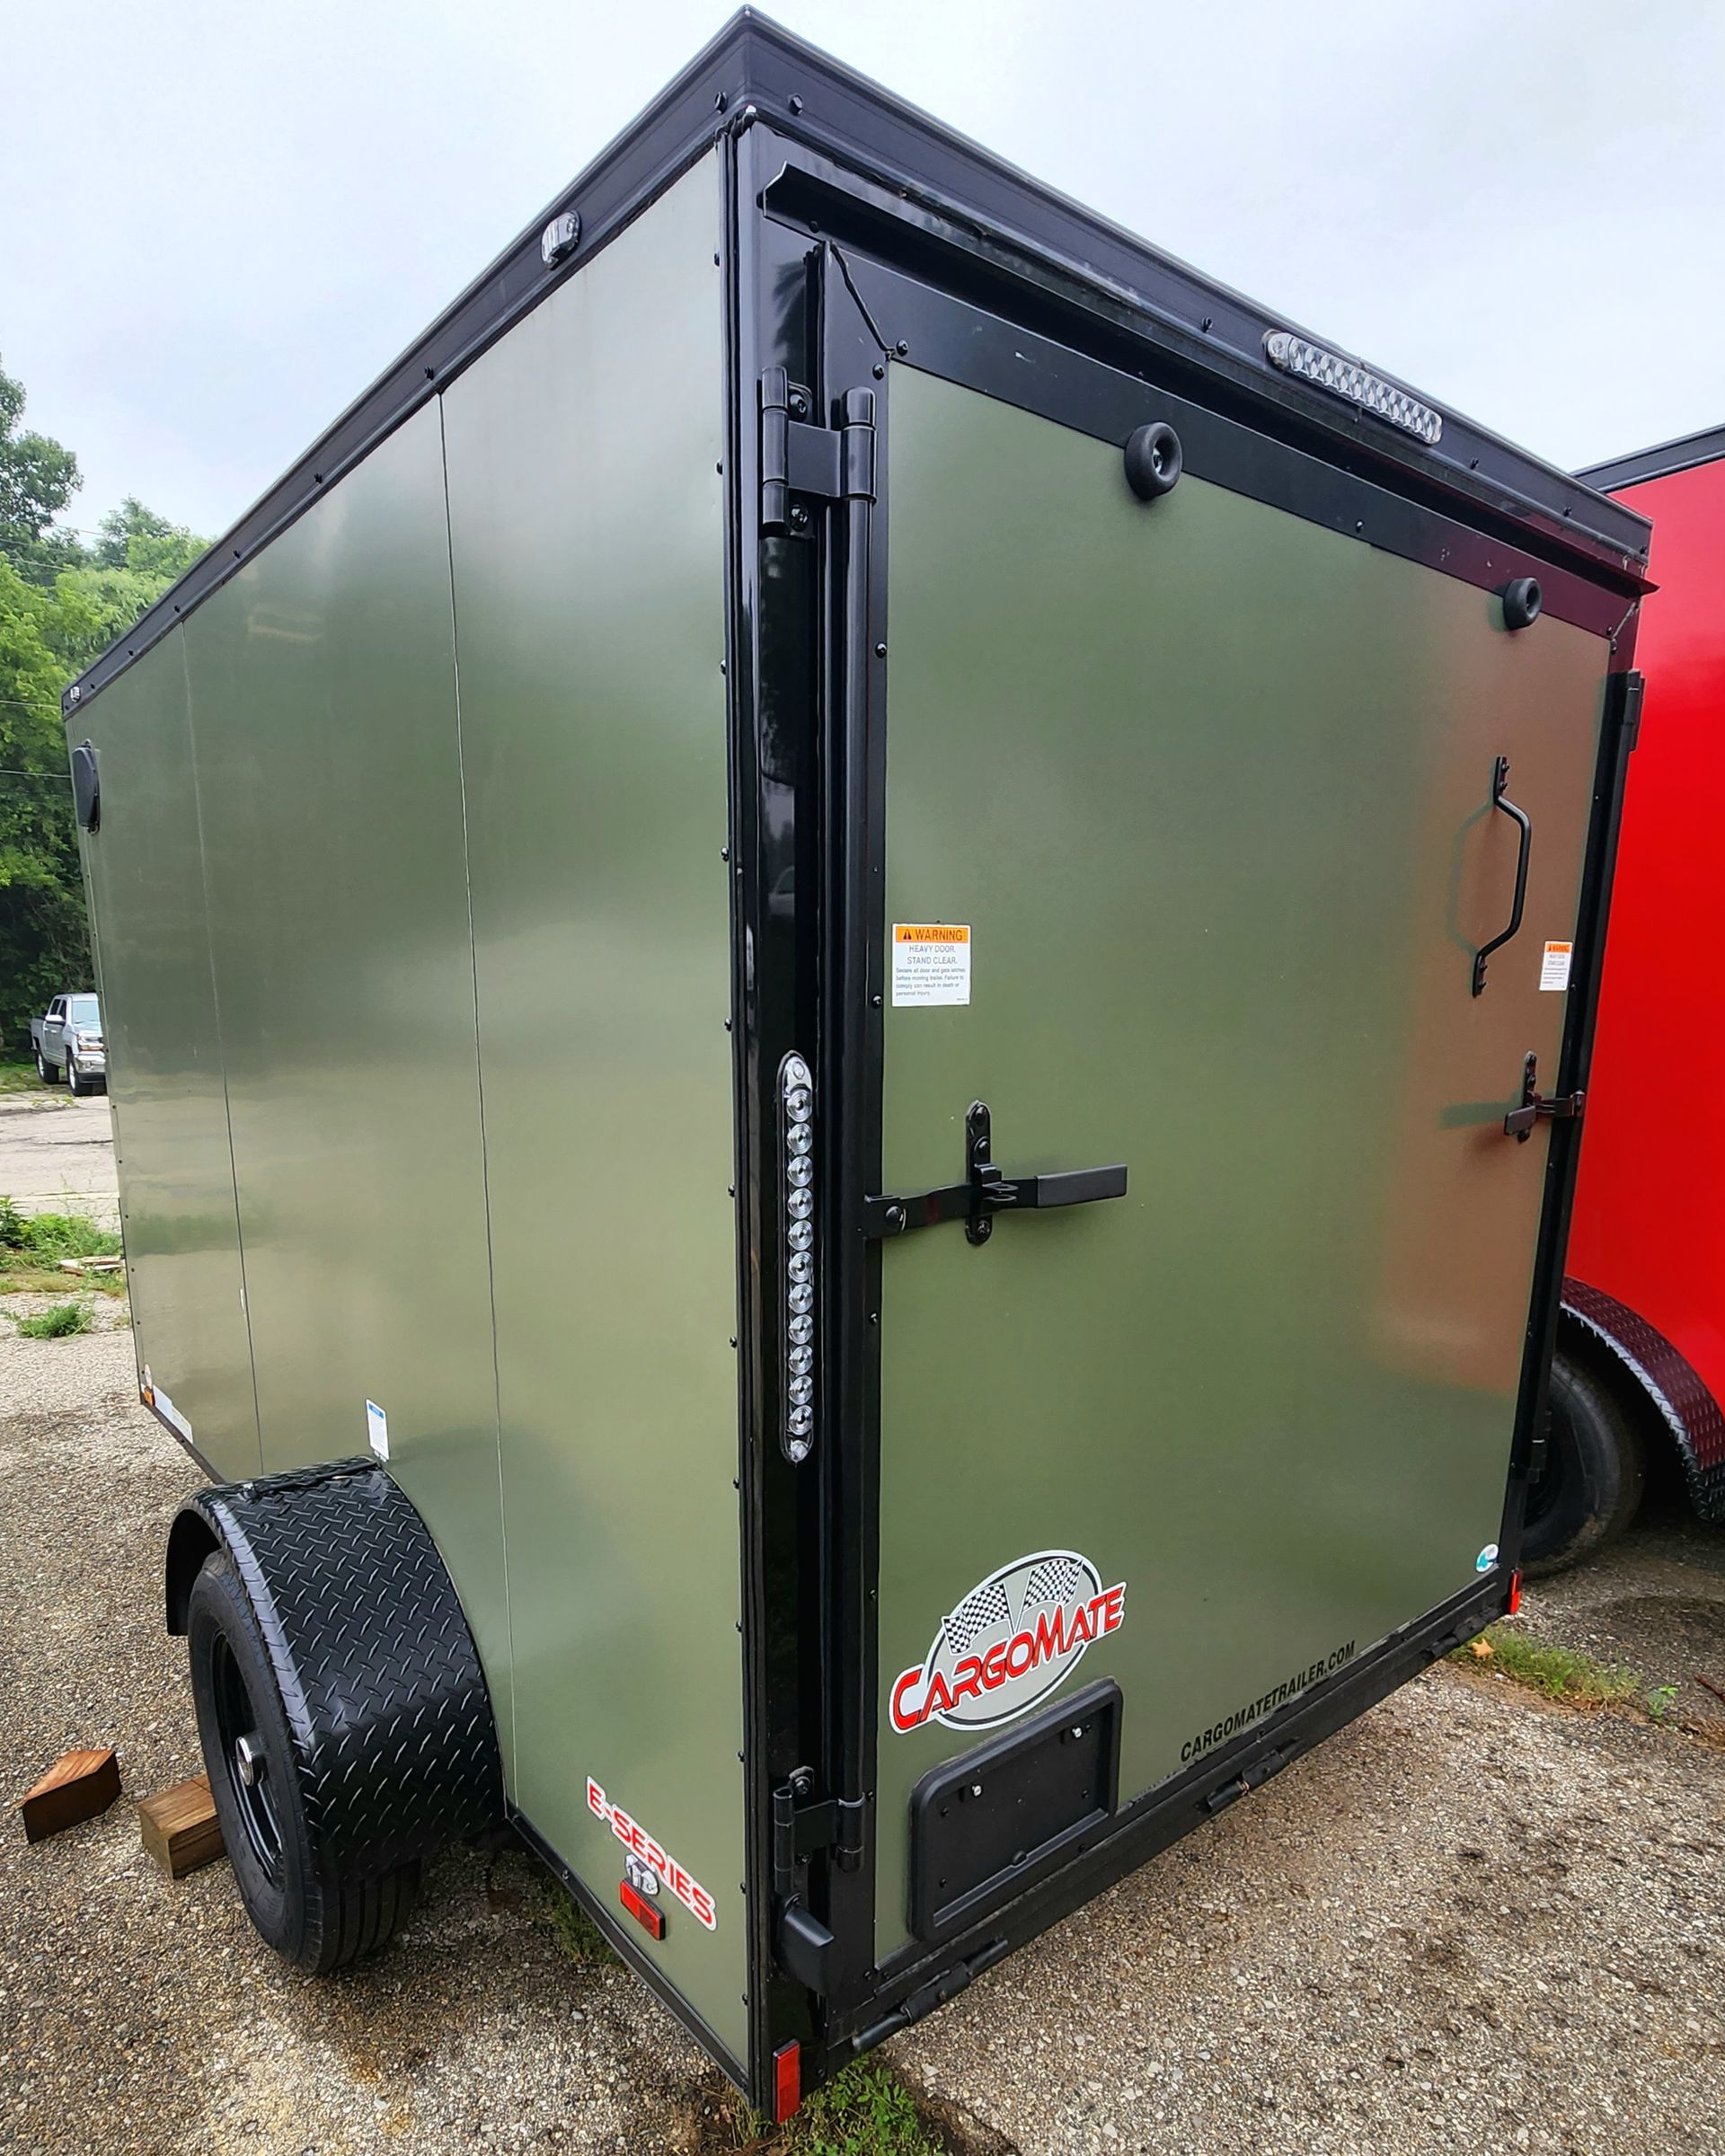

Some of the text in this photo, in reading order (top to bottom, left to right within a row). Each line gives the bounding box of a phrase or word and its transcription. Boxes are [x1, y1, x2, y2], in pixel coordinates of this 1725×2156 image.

[907, 957, 932, 965] STAND
[909, 945, 933, 953] HEAVY
[915, 929, 963, 941] WARNING
[891, 1586, 1125, 1731] CARGOMATE
[1181, 1639, 1356, 1763] CARGOMATETRAILER.COM
[588, 1781, 713, 1926] E-SERIES
